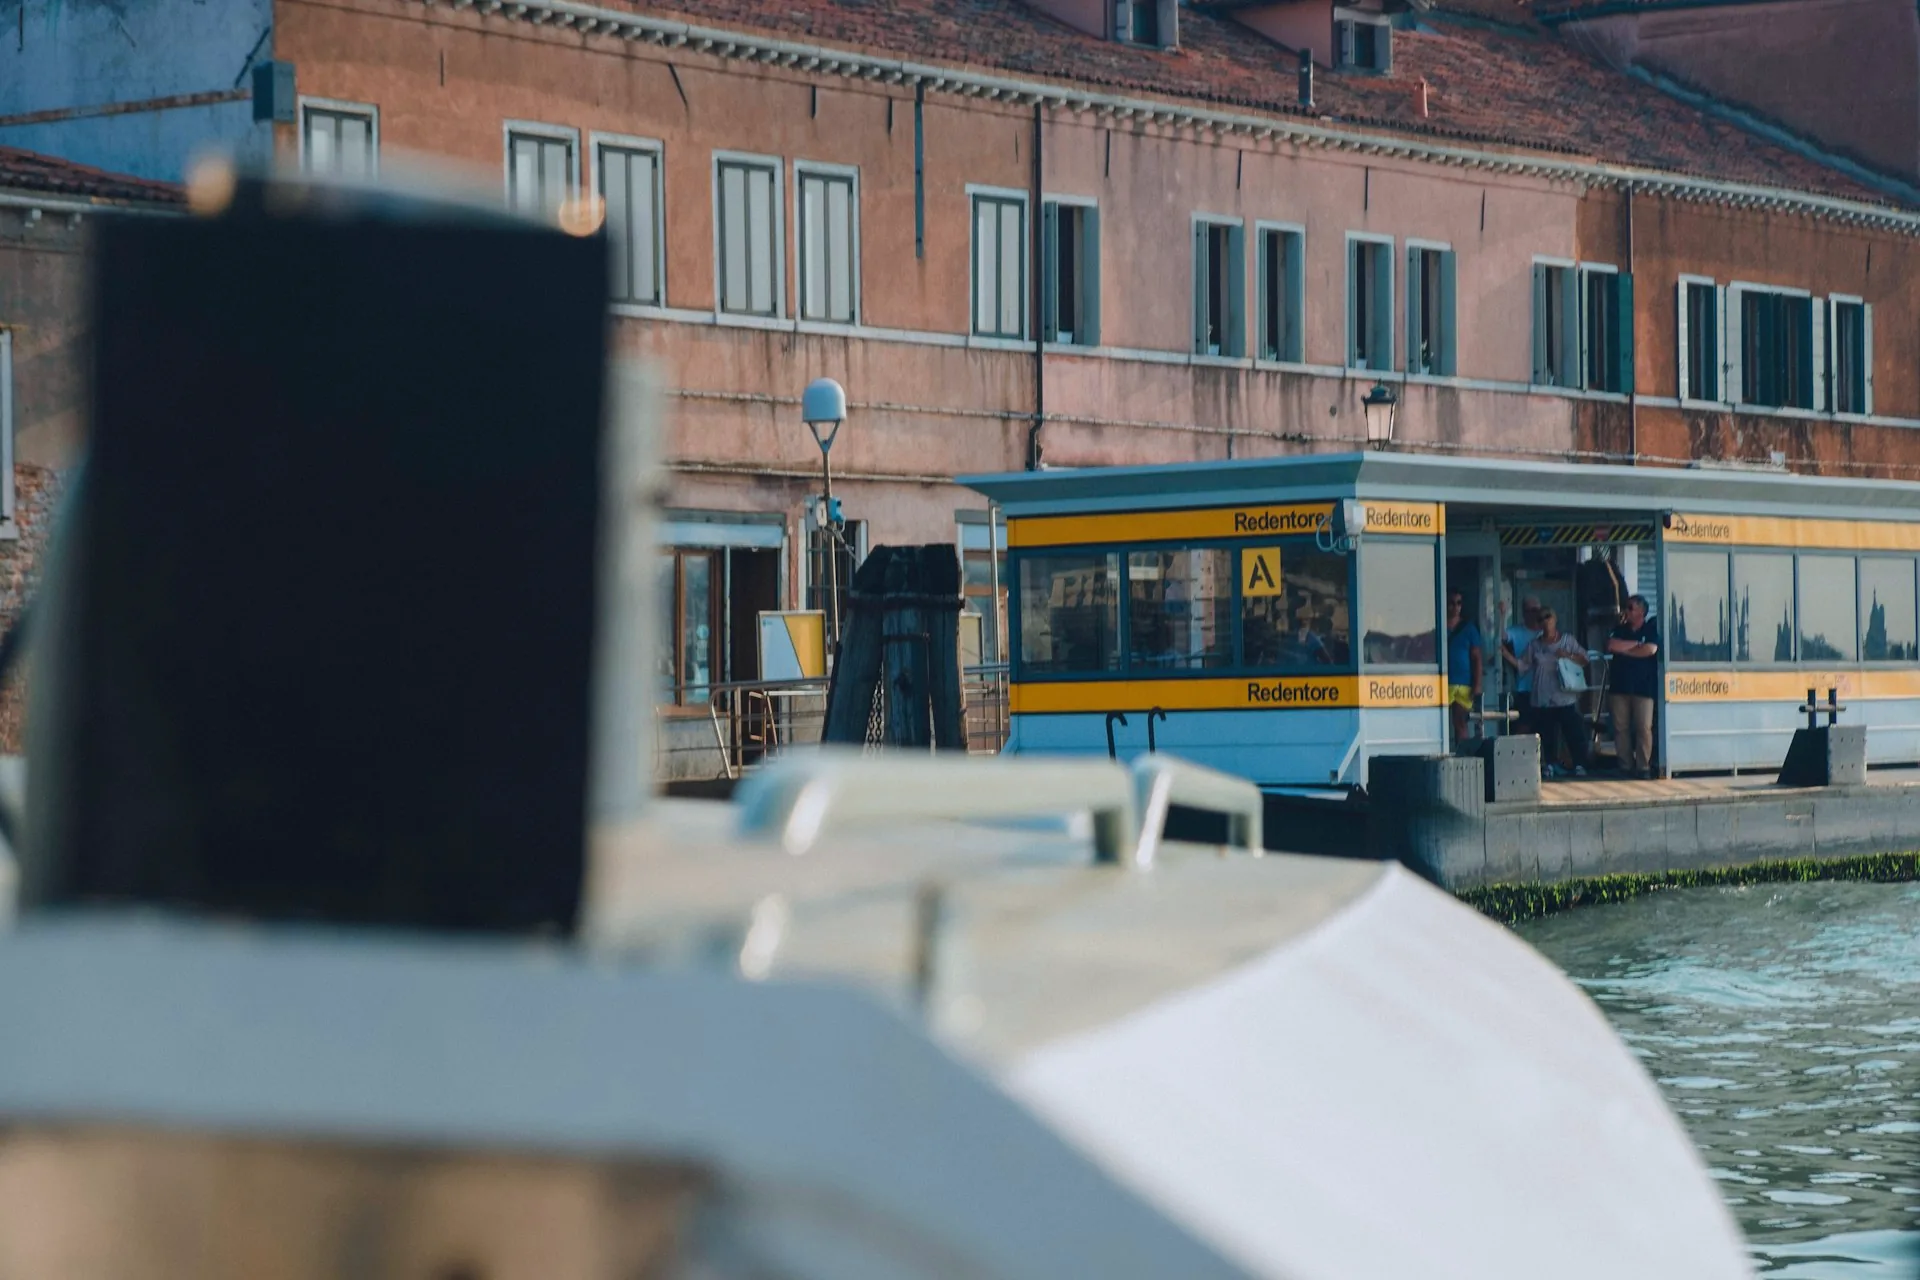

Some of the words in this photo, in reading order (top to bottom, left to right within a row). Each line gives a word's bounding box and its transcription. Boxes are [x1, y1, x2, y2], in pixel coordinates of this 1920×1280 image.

[1234, 510, 1326, 532] Redentore
[1366, 508, 1431, 528] Redentore
[1249, 554, 1275, 589] A
[1247, 682, 1339, 702] Redentore
[1369, 681, 1434, 700] Redentore
[1675, 677, 1729, 696] Redentore
